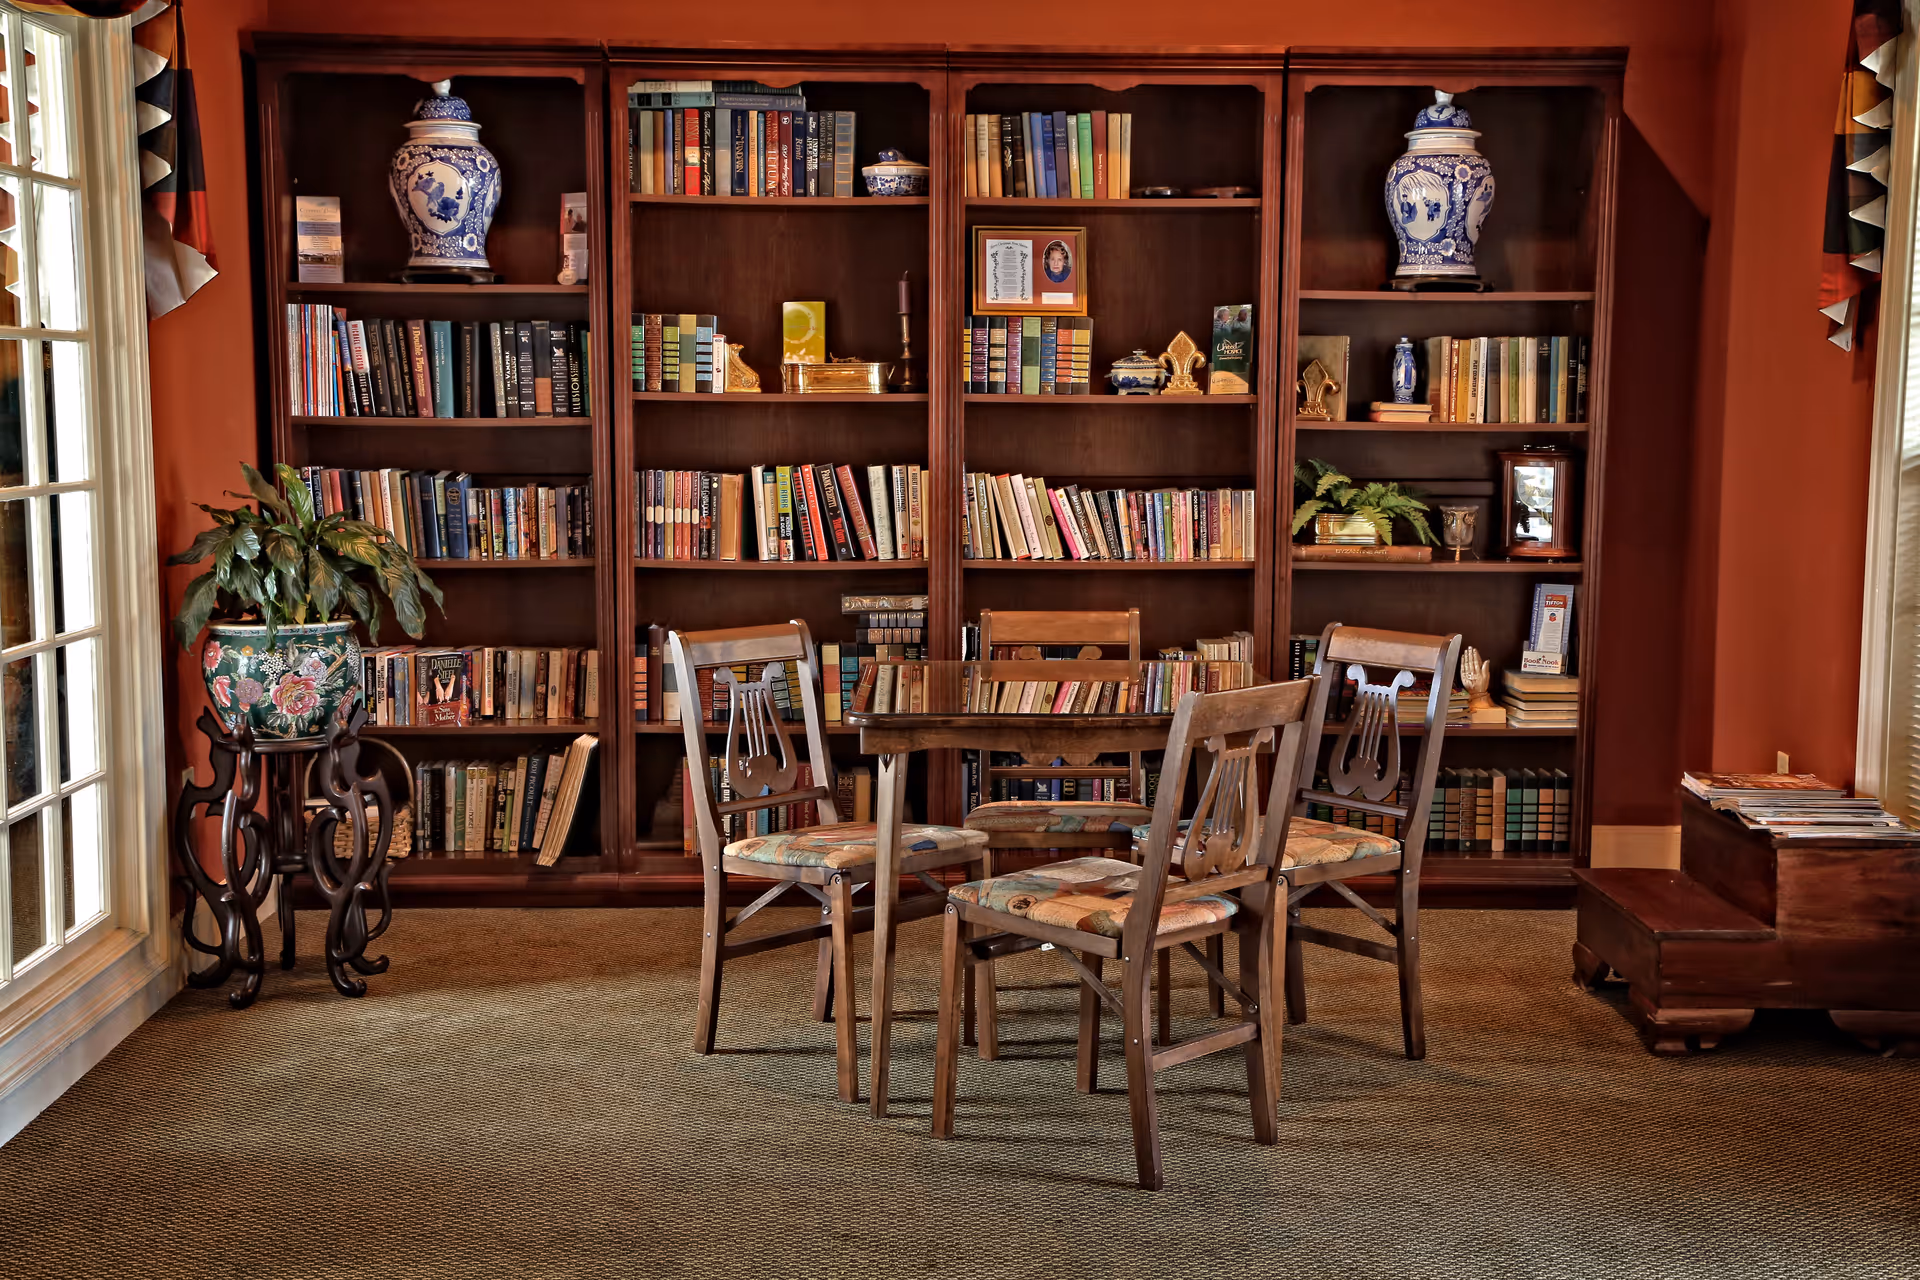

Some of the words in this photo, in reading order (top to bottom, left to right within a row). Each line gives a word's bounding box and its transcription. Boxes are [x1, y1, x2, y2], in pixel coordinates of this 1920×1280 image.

[767, 150, 776, 189] ILIUM
[413, 330, 424, 355] Double
[355, 346, 364, 370] CRICHTON
[417, 357, 425, 373] Play
[358, 373, 366, 387] STATE
[571, 373, 581, 413] ILLUSIONS
[821, 469, 833, 487] FRANK
[780, 490, 789, 508] ROBB
[825, 486, 837, 508] PERETTI
[793, 472, 804, 500] MICHAEL
[801, 516, 812, 547] CRICHTON
[431, 658, 462, 670] DANIELLE
[531, 757, 539, 773] JODI
[527, 776, 536, 806] PICOULT
